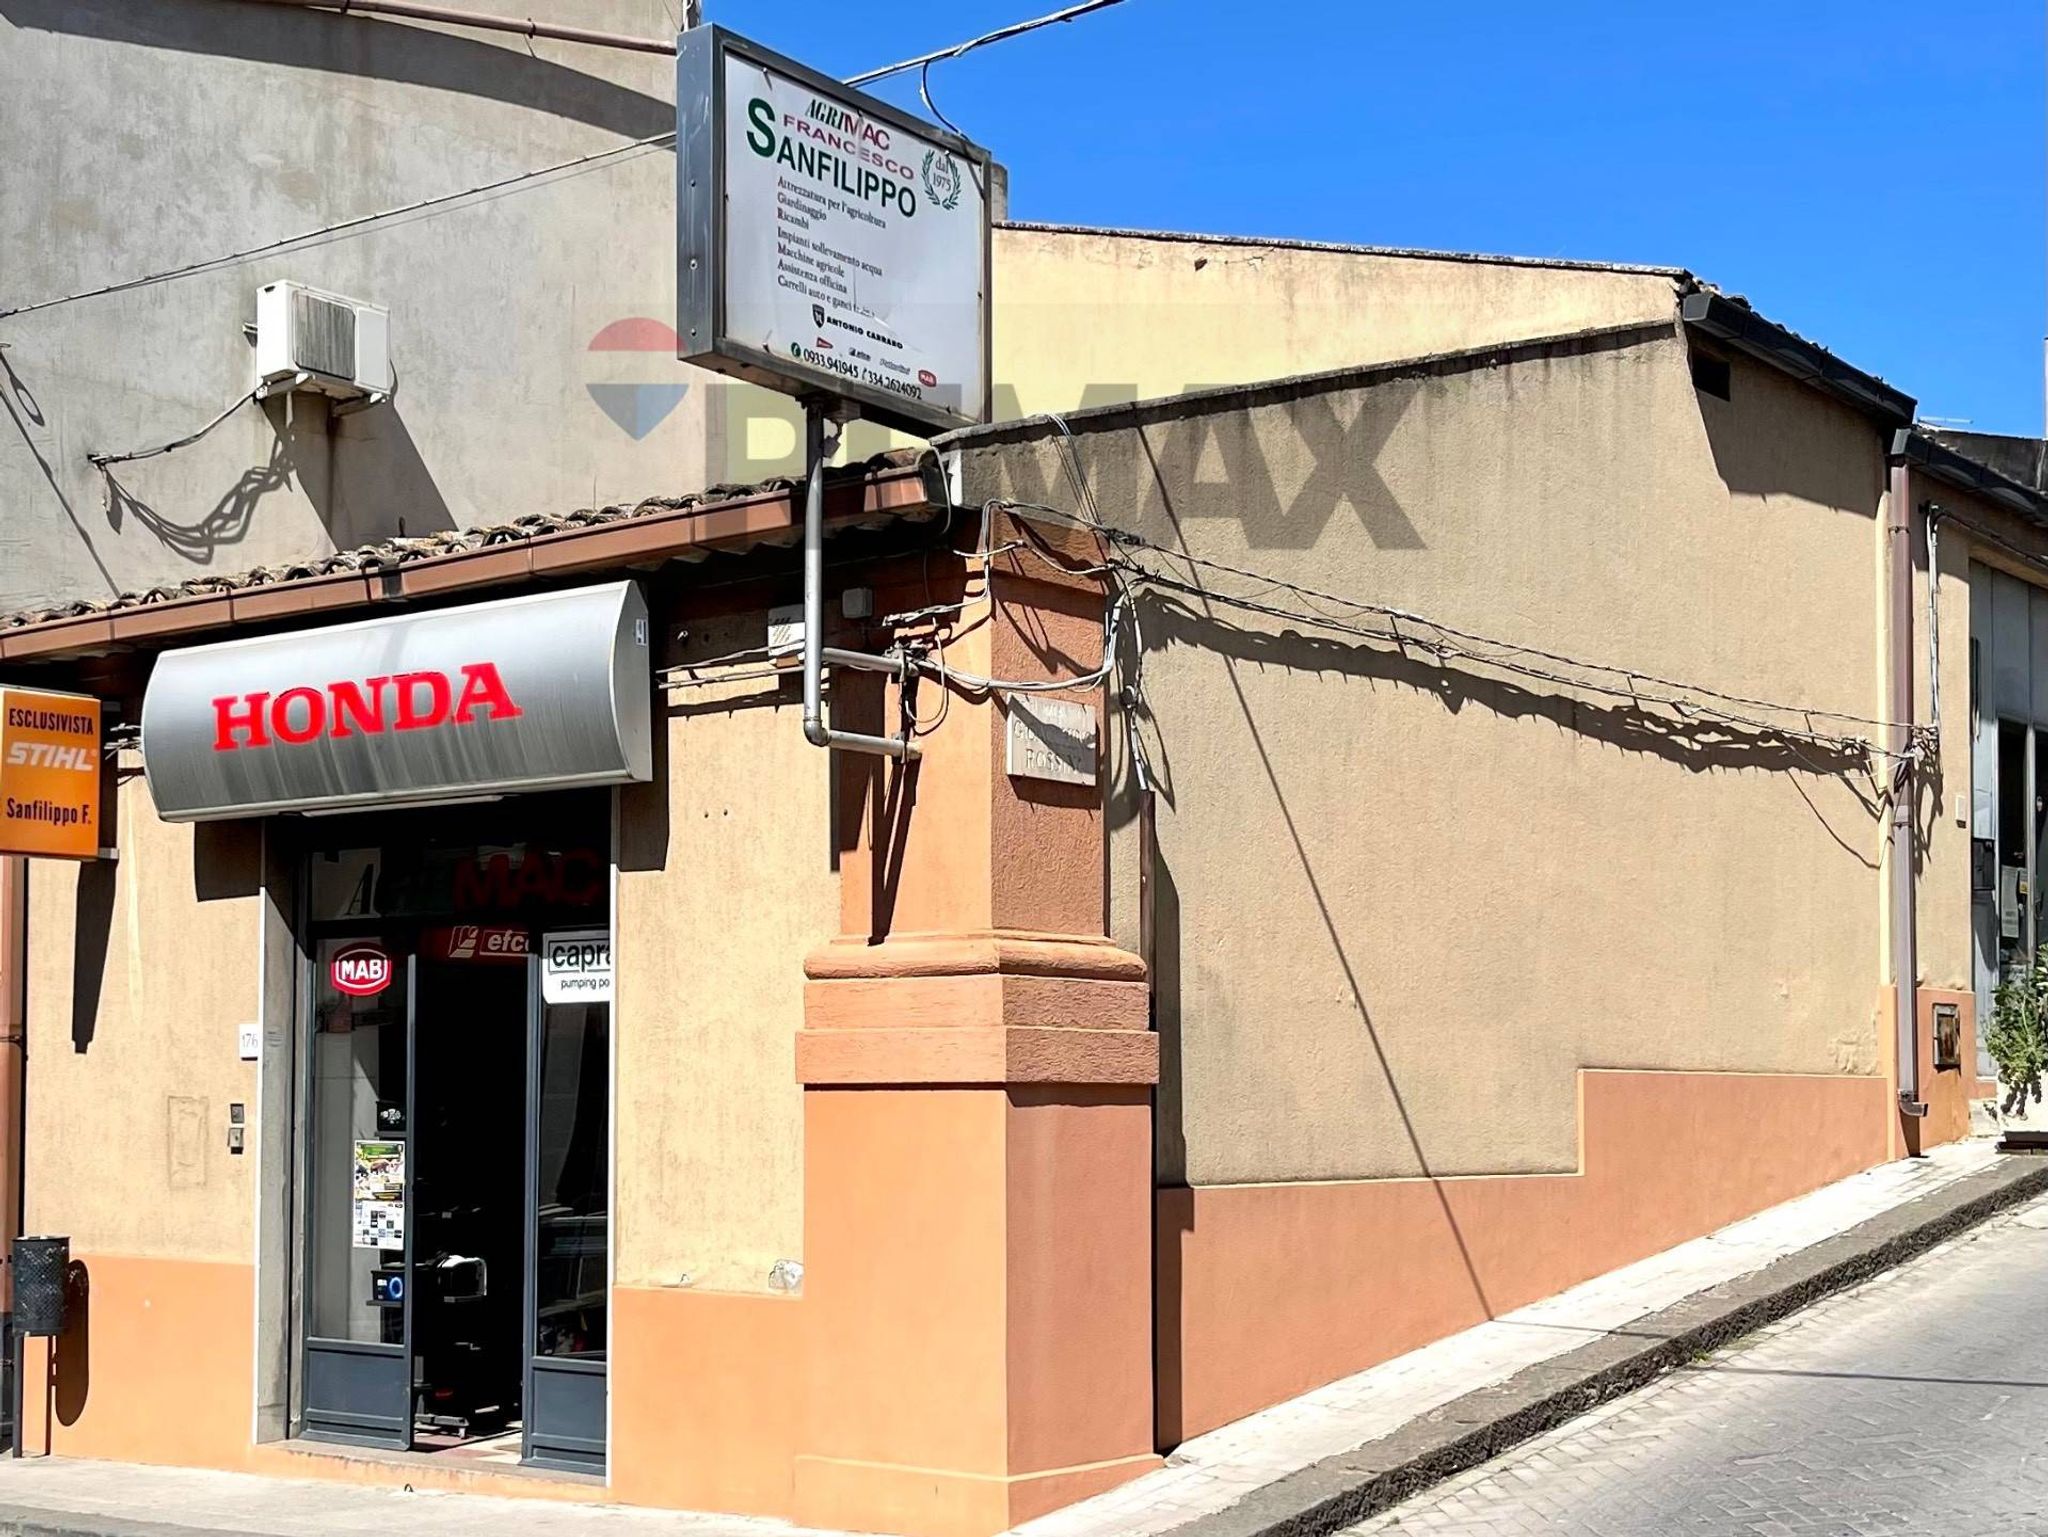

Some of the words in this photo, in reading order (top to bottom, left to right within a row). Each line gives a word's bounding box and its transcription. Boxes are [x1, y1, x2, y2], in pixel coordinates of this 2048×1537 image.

[746, 97, 916, 218] SANFILIPPO
[783, 114, 915, 180] FRANCESCO
[777, 176, 827, 206] Attrezzatura
[828, 198, 841, 211] per
[933, 172, 951, 191] 1975
[777, 191, 828, 221] Giardinaggio
[777, 206, 810, 231] Ricambi
[777, 226, 811, 249] Impianti
[811, 241, 861, 268] sollevamento
[861, 261, 883, 277] acqua
[777, 241, 815, 266] Macchine
[816, 260, 845, 279] agricole
[777, 258, 818, 284] Assistenza
[819, 275, 848, 294] officina
[777, 274, 807, 295] Carrelli
[808, 287, 826, 301] auto
[826, 316, 864, 336] ANTONIO
[212, 662, 523, 751] HONDA
[8, 708, 94, 735] ESCLUSIVISTA
[7, 741, 94, 771] STIHL
[7, 797, 78, 826] Sanfilippo
[82, 804, 92, 825] F.
[487, 929, 529, 952] efc
[341, 958, 383, 980] MAB
[560, 978, 597, 991] pumping
